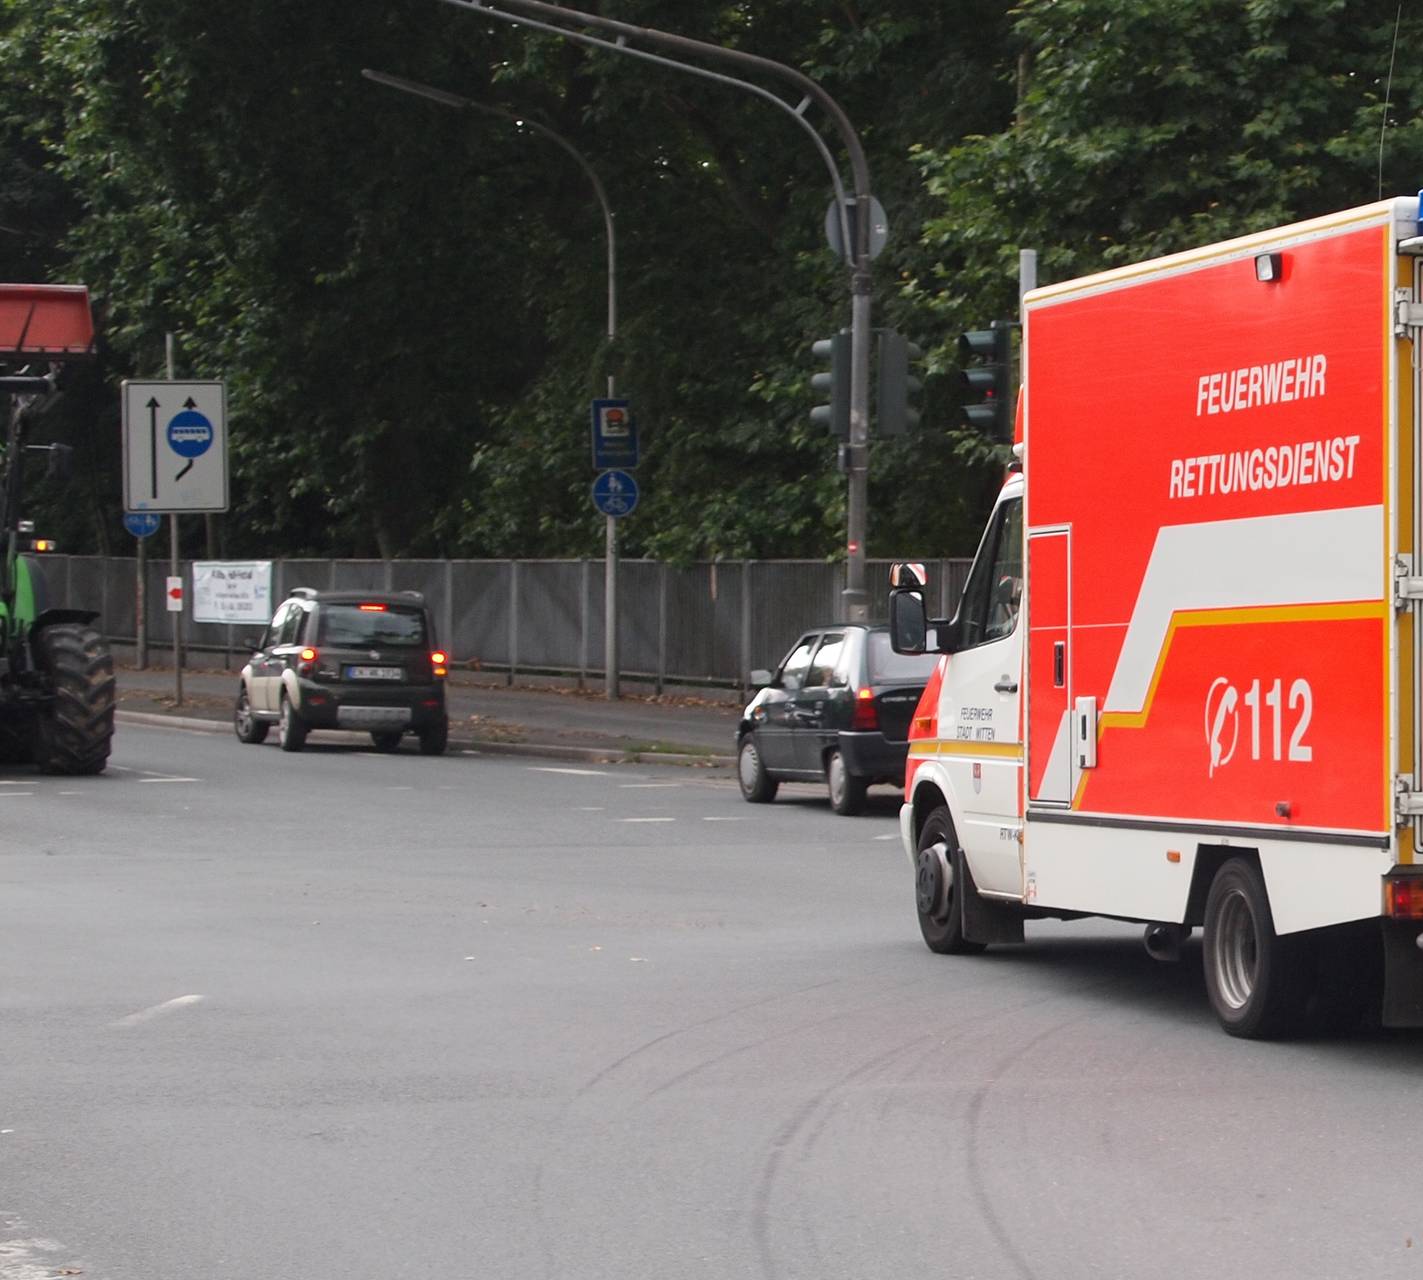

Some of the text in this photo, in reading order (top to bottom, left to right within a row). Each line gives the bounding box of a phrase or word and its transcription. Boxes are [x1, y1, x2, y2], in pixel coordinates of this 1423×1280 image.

[1196, 354, 1327, 416] FEUERWEHR
[1169, 435, 1360, 499] RETTUNGSDIENST
[956, 725, 995, 741] STADT WITTEN
[960, 707, 993, 721] FEUERWEHR
[1244, 678, 1313, 762] 112
